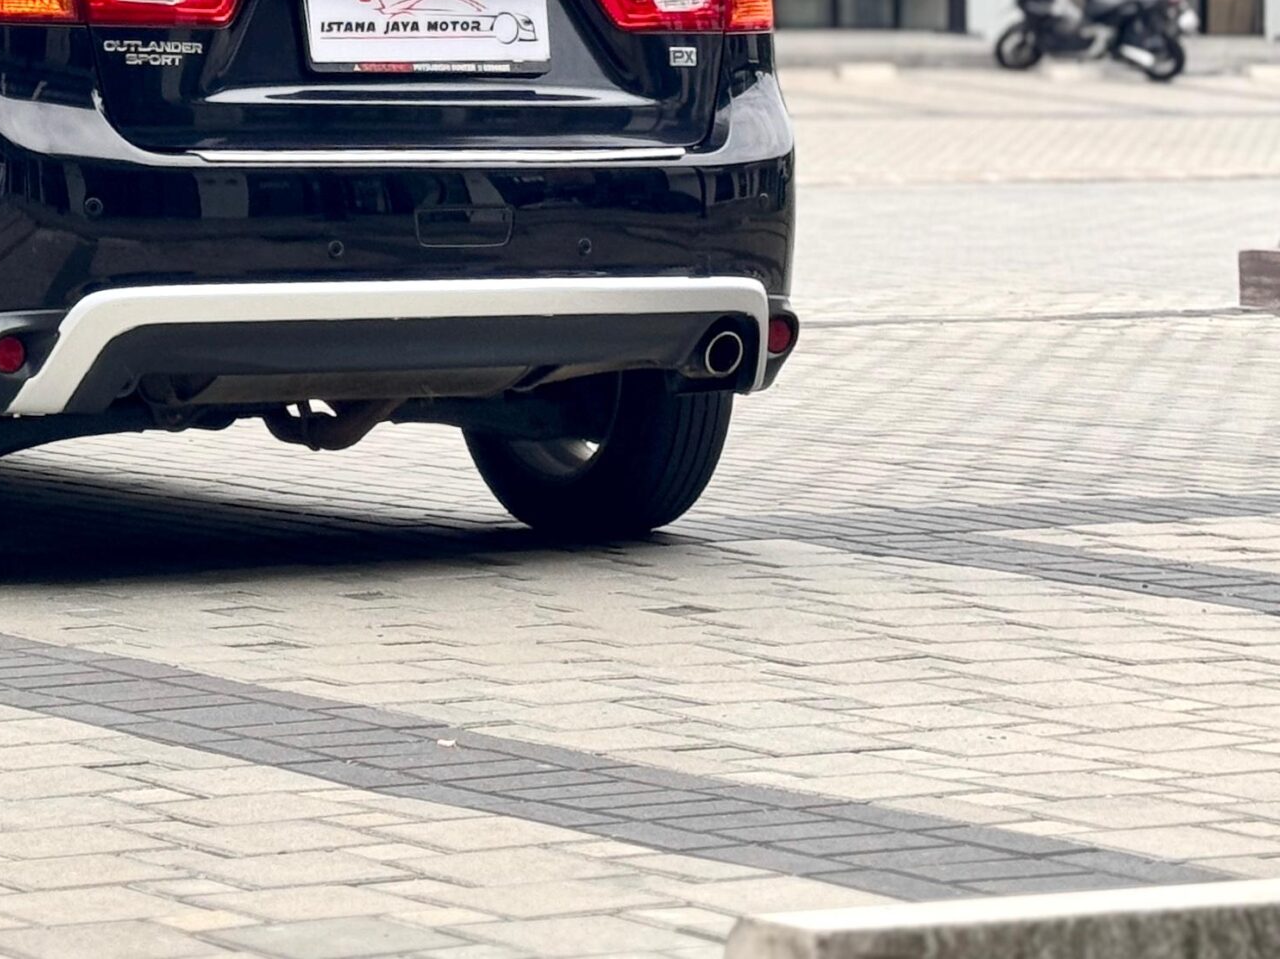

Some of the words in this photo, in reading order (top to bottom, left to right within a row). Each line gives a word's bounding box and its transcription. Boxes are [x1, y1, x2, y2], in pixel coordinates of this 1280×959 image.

[320, 21, 376, 33] ISTANA
[383, 21, 420, 35] JAYA
[426, 19, 482, 32] MOTOR
[103, 39, 203, 54] OUTLANDER
[125, 53, 183, 66] SPORT
[671, 48, 696, 65] PX
